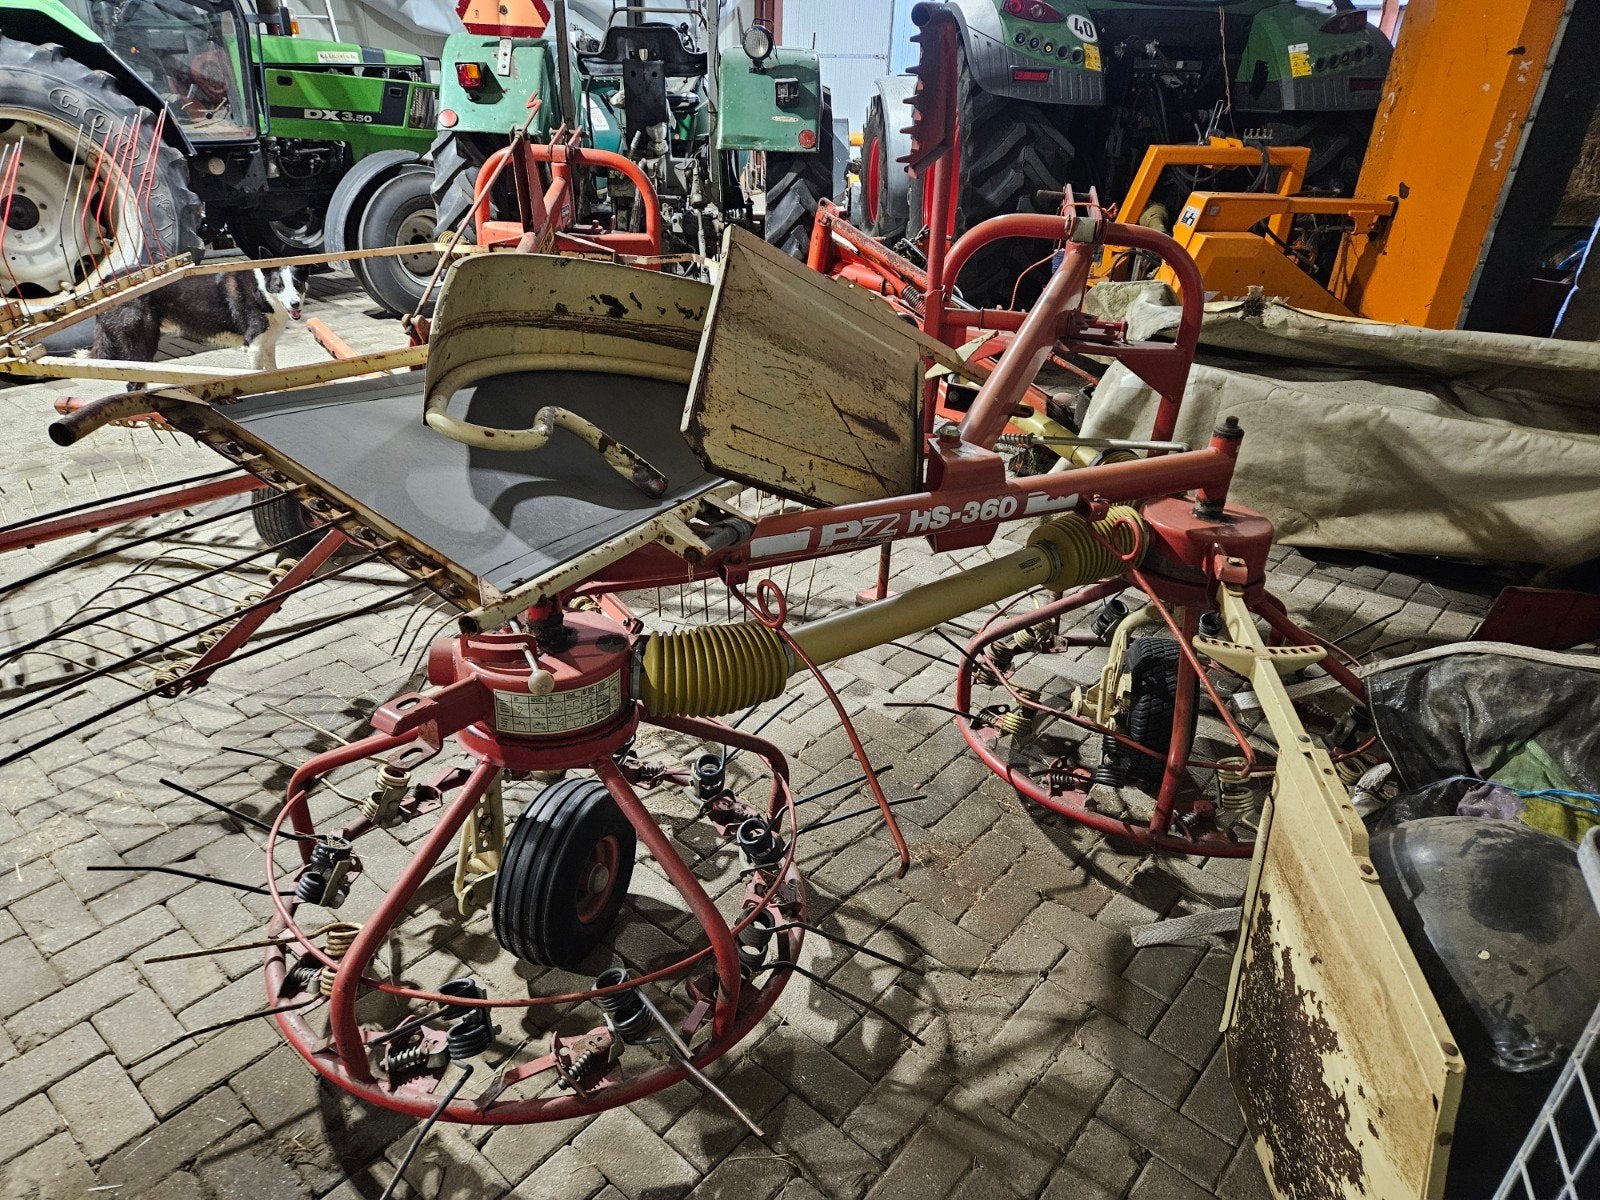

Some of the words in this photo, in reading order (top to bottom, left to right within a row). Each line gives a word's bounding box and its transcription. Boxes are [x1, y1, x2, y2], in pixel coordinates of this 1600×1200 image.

[1074, 17, 1094, 38] 40
[304, 109, 340, 121] DX
[341, 111, 373, 123] 3.50
[819, 513, 900, 548] PZ
[907, 496, 1018, 533] HS-360
